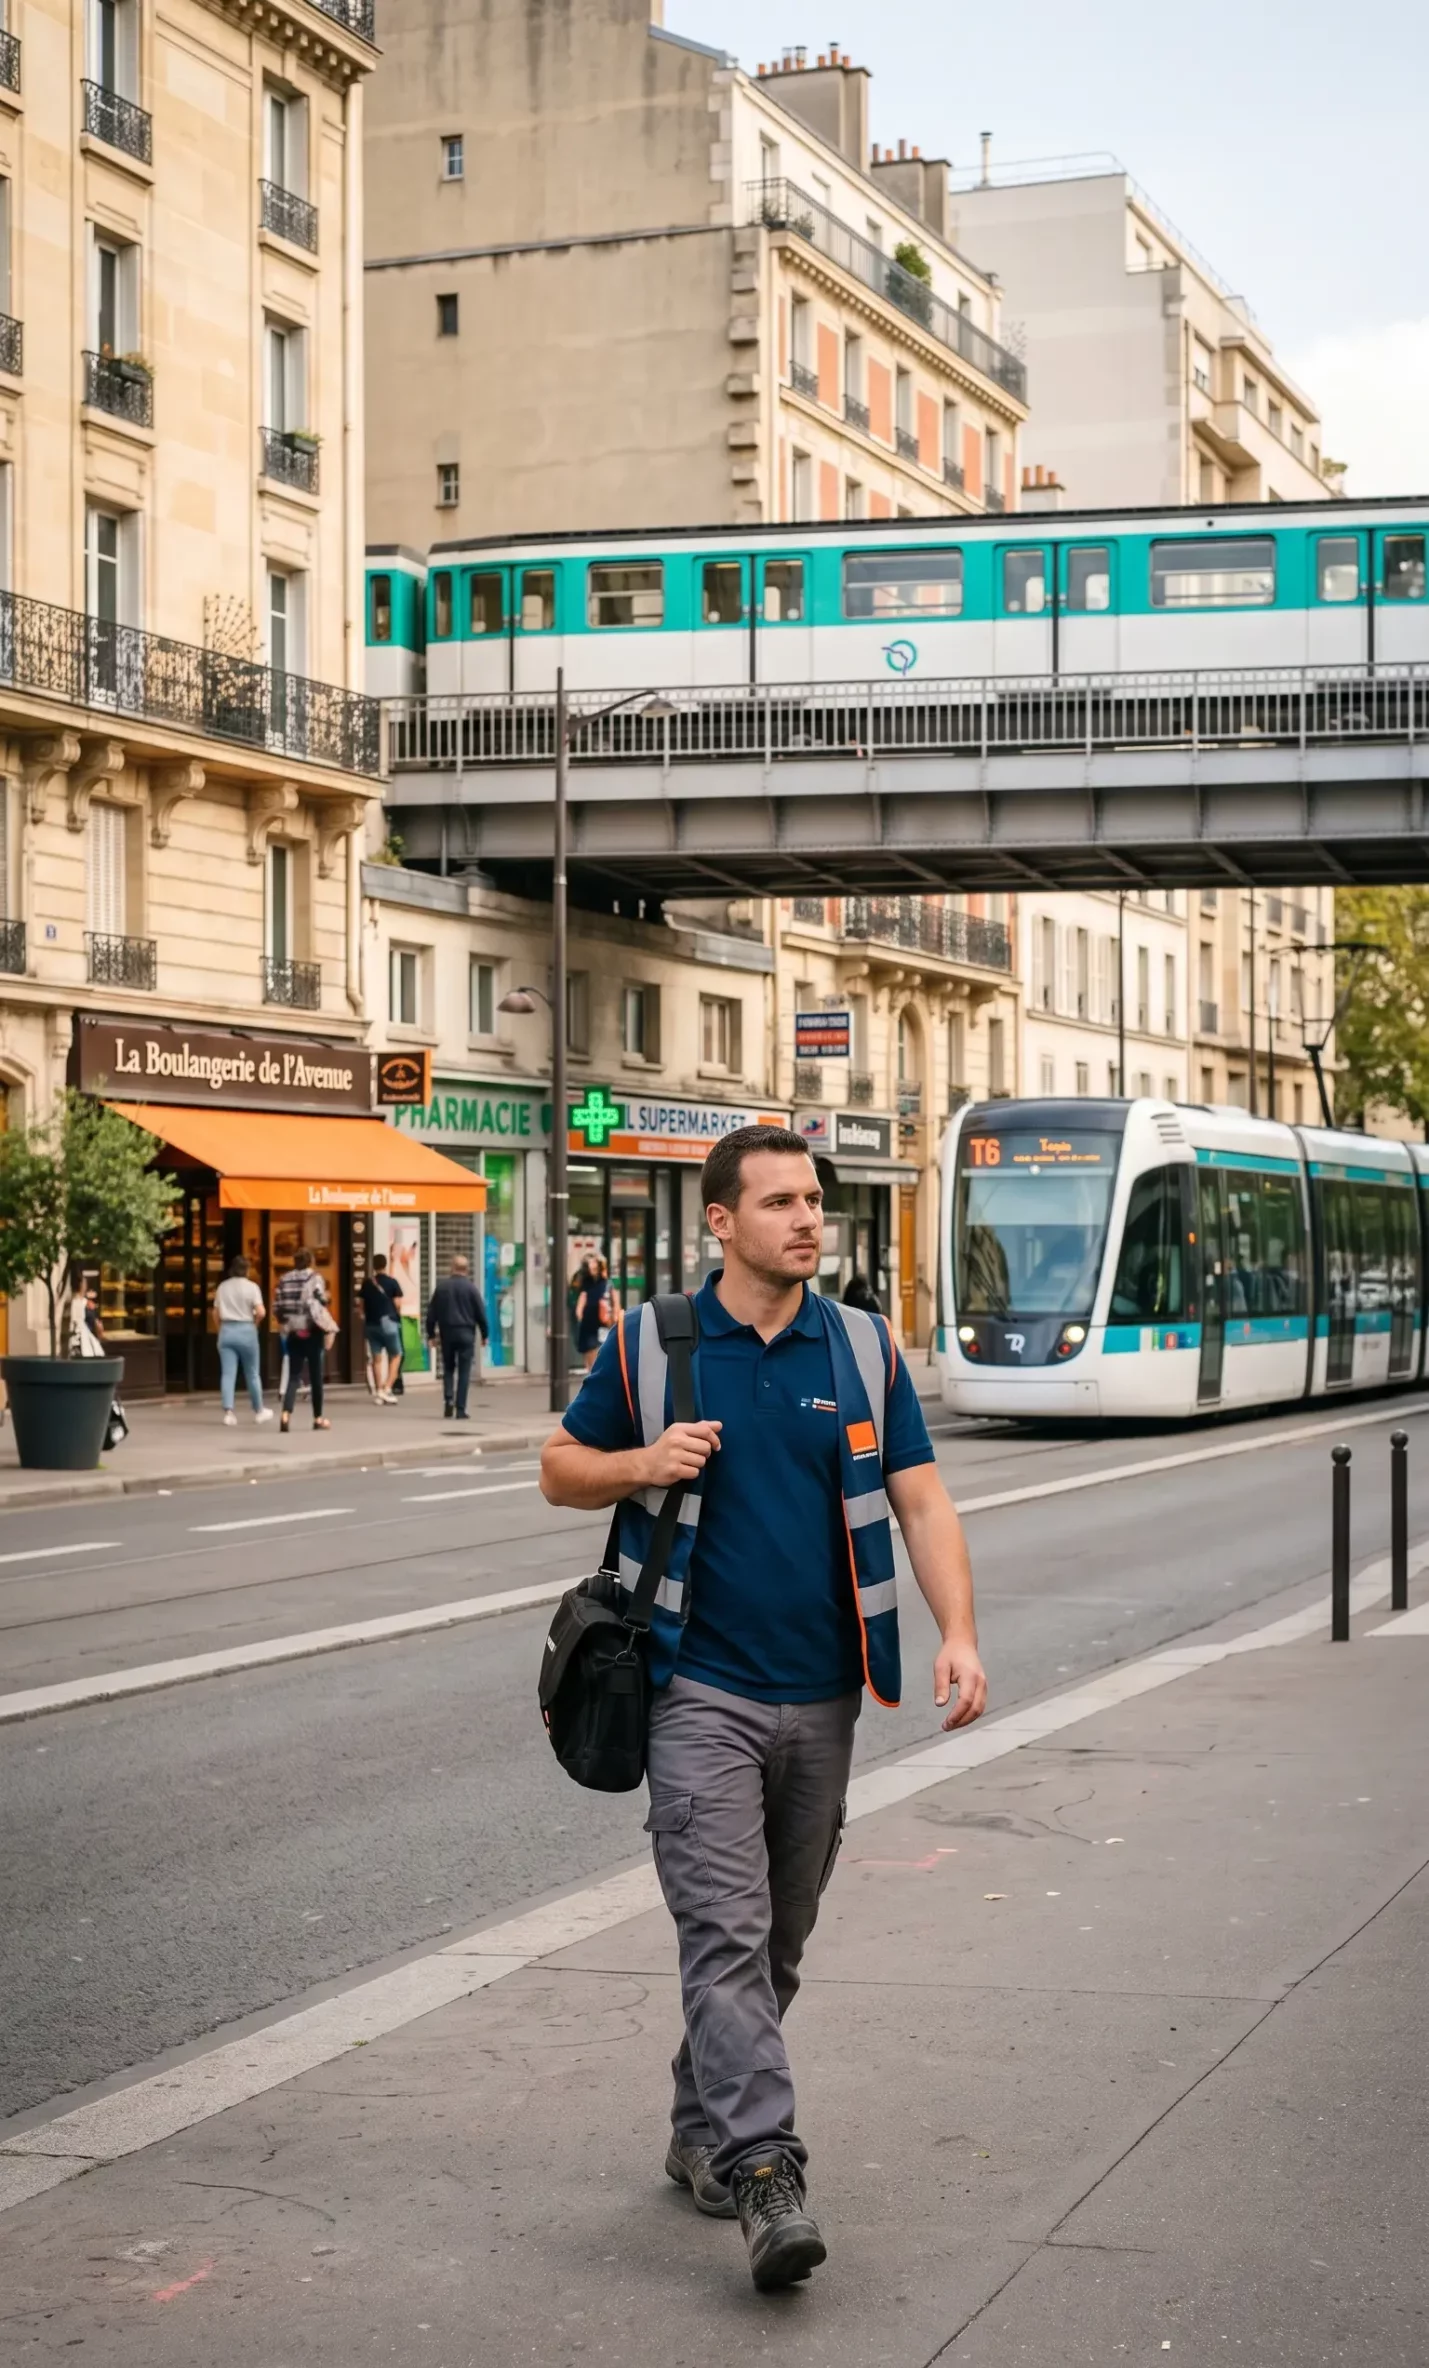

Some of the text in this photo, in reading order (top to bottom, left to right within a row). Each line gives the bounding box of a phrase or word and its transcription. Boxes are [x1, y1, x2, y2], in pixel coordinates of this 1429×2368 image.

[114, 1038, 141, 1073] La
[145, 1041, 255, 1089] Boulangerie
[258, 1051, 280, 1085] de
[283, 1053, 353, 1090] l'Avenue
[394, 1096, 531, 1136] PHARMACIE
[639, 1106, 746, 1136] SUPERMARKET
[970, 1138, 1000, 1166] T6
